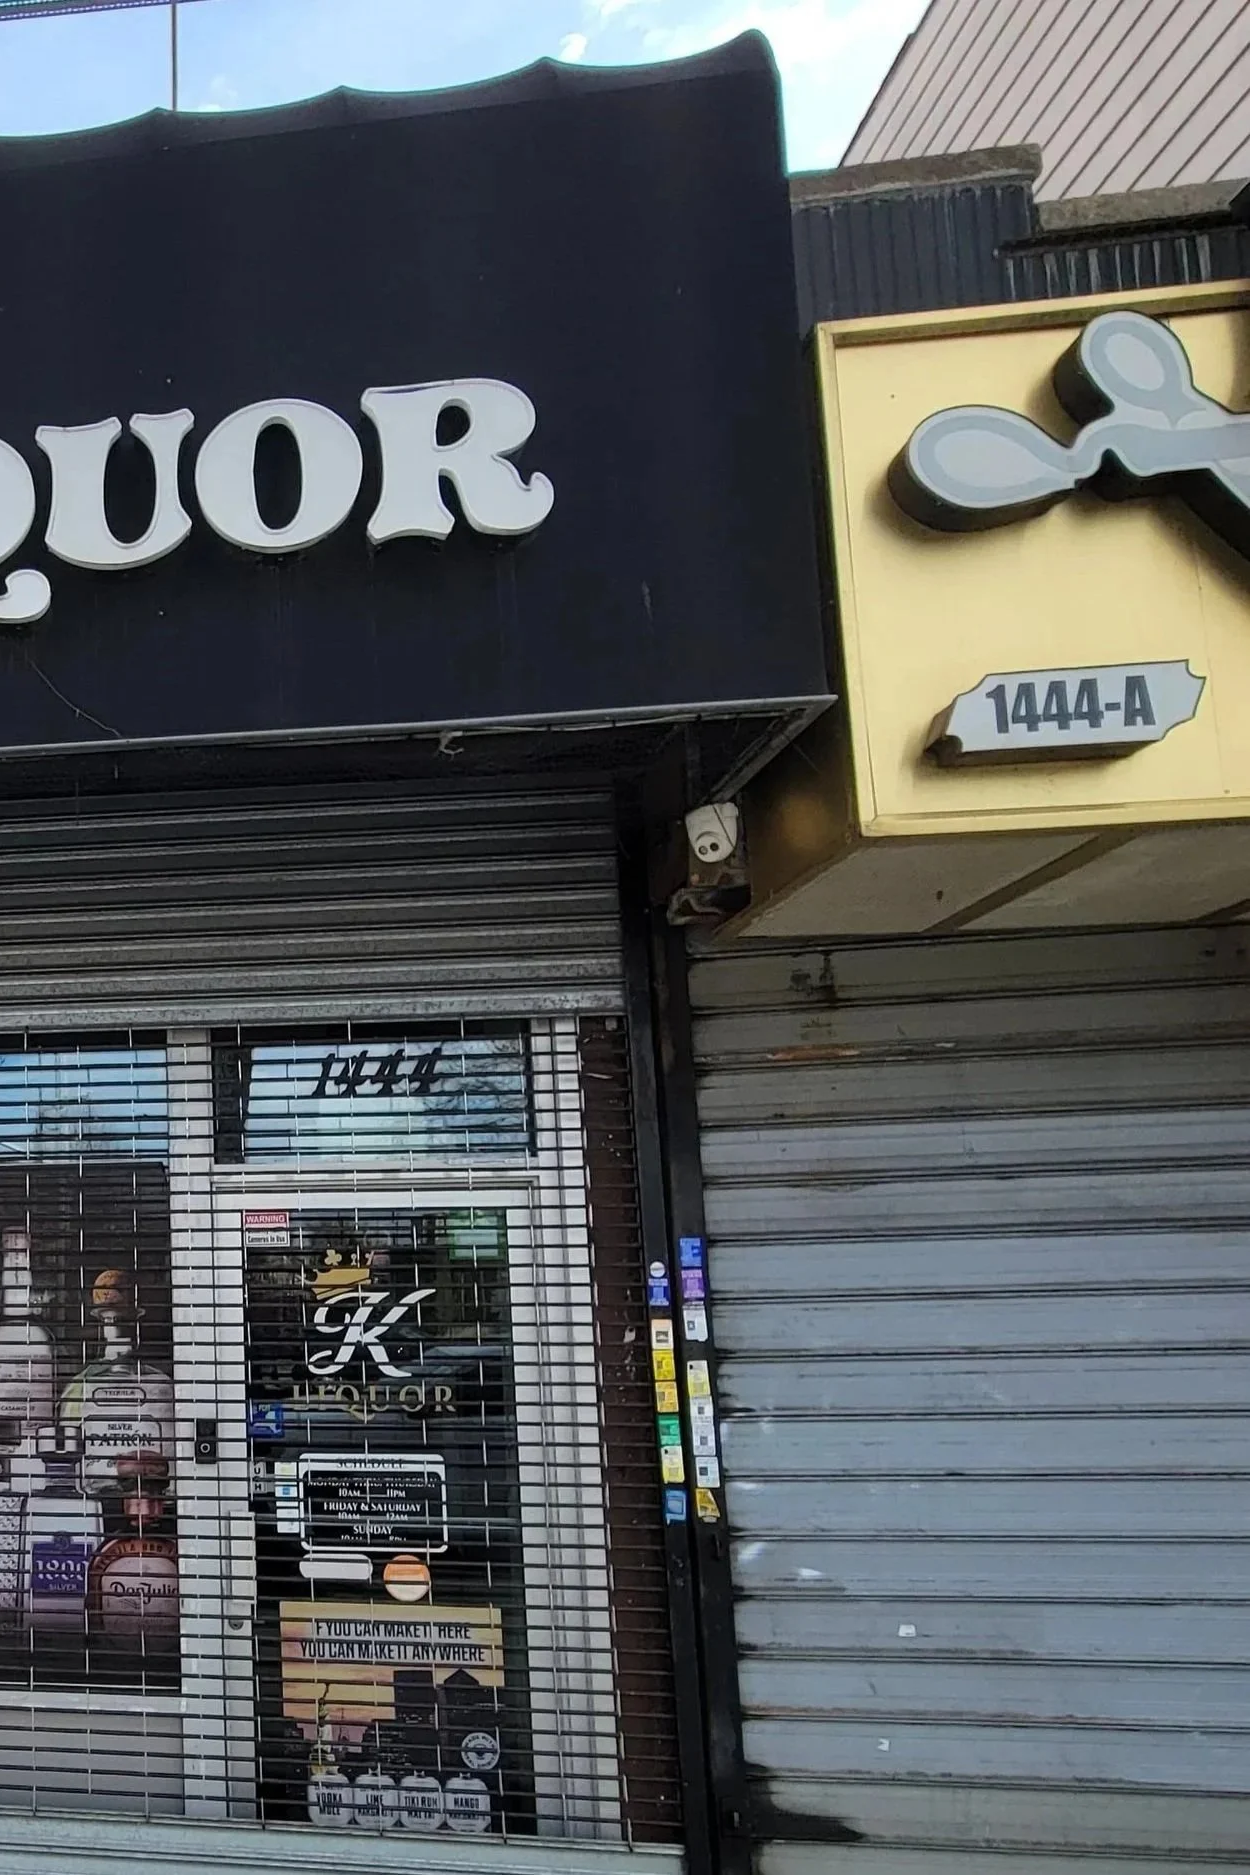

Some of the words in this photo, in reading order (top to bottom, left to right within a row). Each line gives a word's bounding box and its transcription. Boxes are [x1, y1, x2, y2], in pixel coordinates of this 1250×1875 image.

[985, 675, 1156, 734] 1444-A
[246, 1214, 285, 1223] WARNING
[308, 1288, 436, 1378] K
[293, 1385, 456, 1421] LIQUOR
[108, 1423, 133, 1431] SILVER
[338, 1488, 361, 1497] 10AM
[323, 1501, 358, 1511] FRIDAY
[360, 1502, 369, 1511] &
[370, 1503, 422, 1512] SATURDAY
[353, 1524, 393, 1534] SUNDAY
[326, 1621, 351, 1636] YOU
[355, 1622, 380, 1638] CAN
[384, 1623, 421, 1639] MAKE
[301, 1640, 325, 1657] YOU
[329, 1642, 355, 1658] CAN
[358, 1643, 395, 1660] MAKE
[412, 1645, 485, 1662] ANYWHERE
